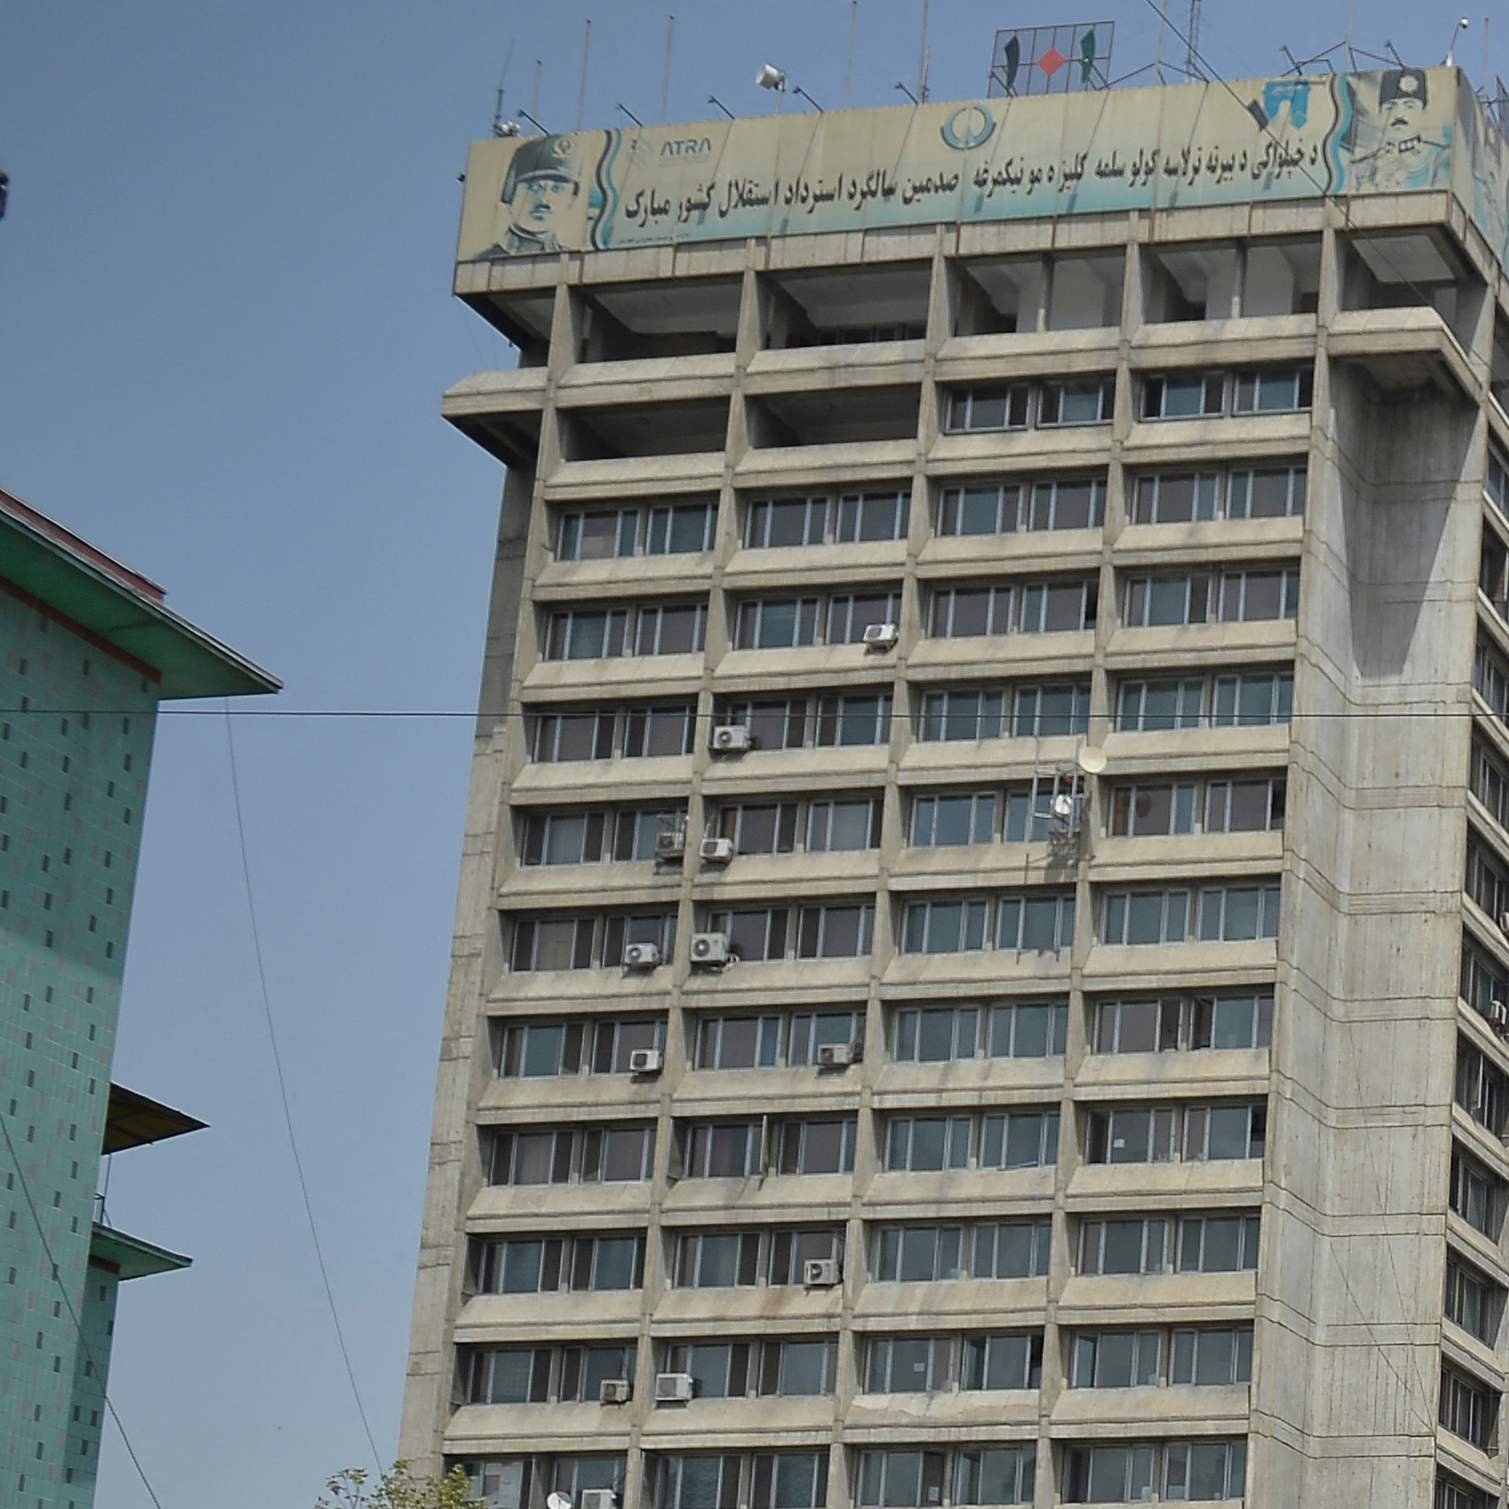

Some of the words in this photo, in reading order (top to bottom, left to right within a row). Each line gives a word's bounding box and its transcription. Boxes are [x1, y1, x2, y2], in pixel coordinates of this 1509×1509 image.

[660, 137, 712, 156] ATRA
[625, 188, 671, 228] مبارک
[677, 182, 716, 224] کشور
[718, 178, 780, 219] استقلال
[783, 173, 844, 215] استرداد
[902, 171, 960, 206] صدمین
